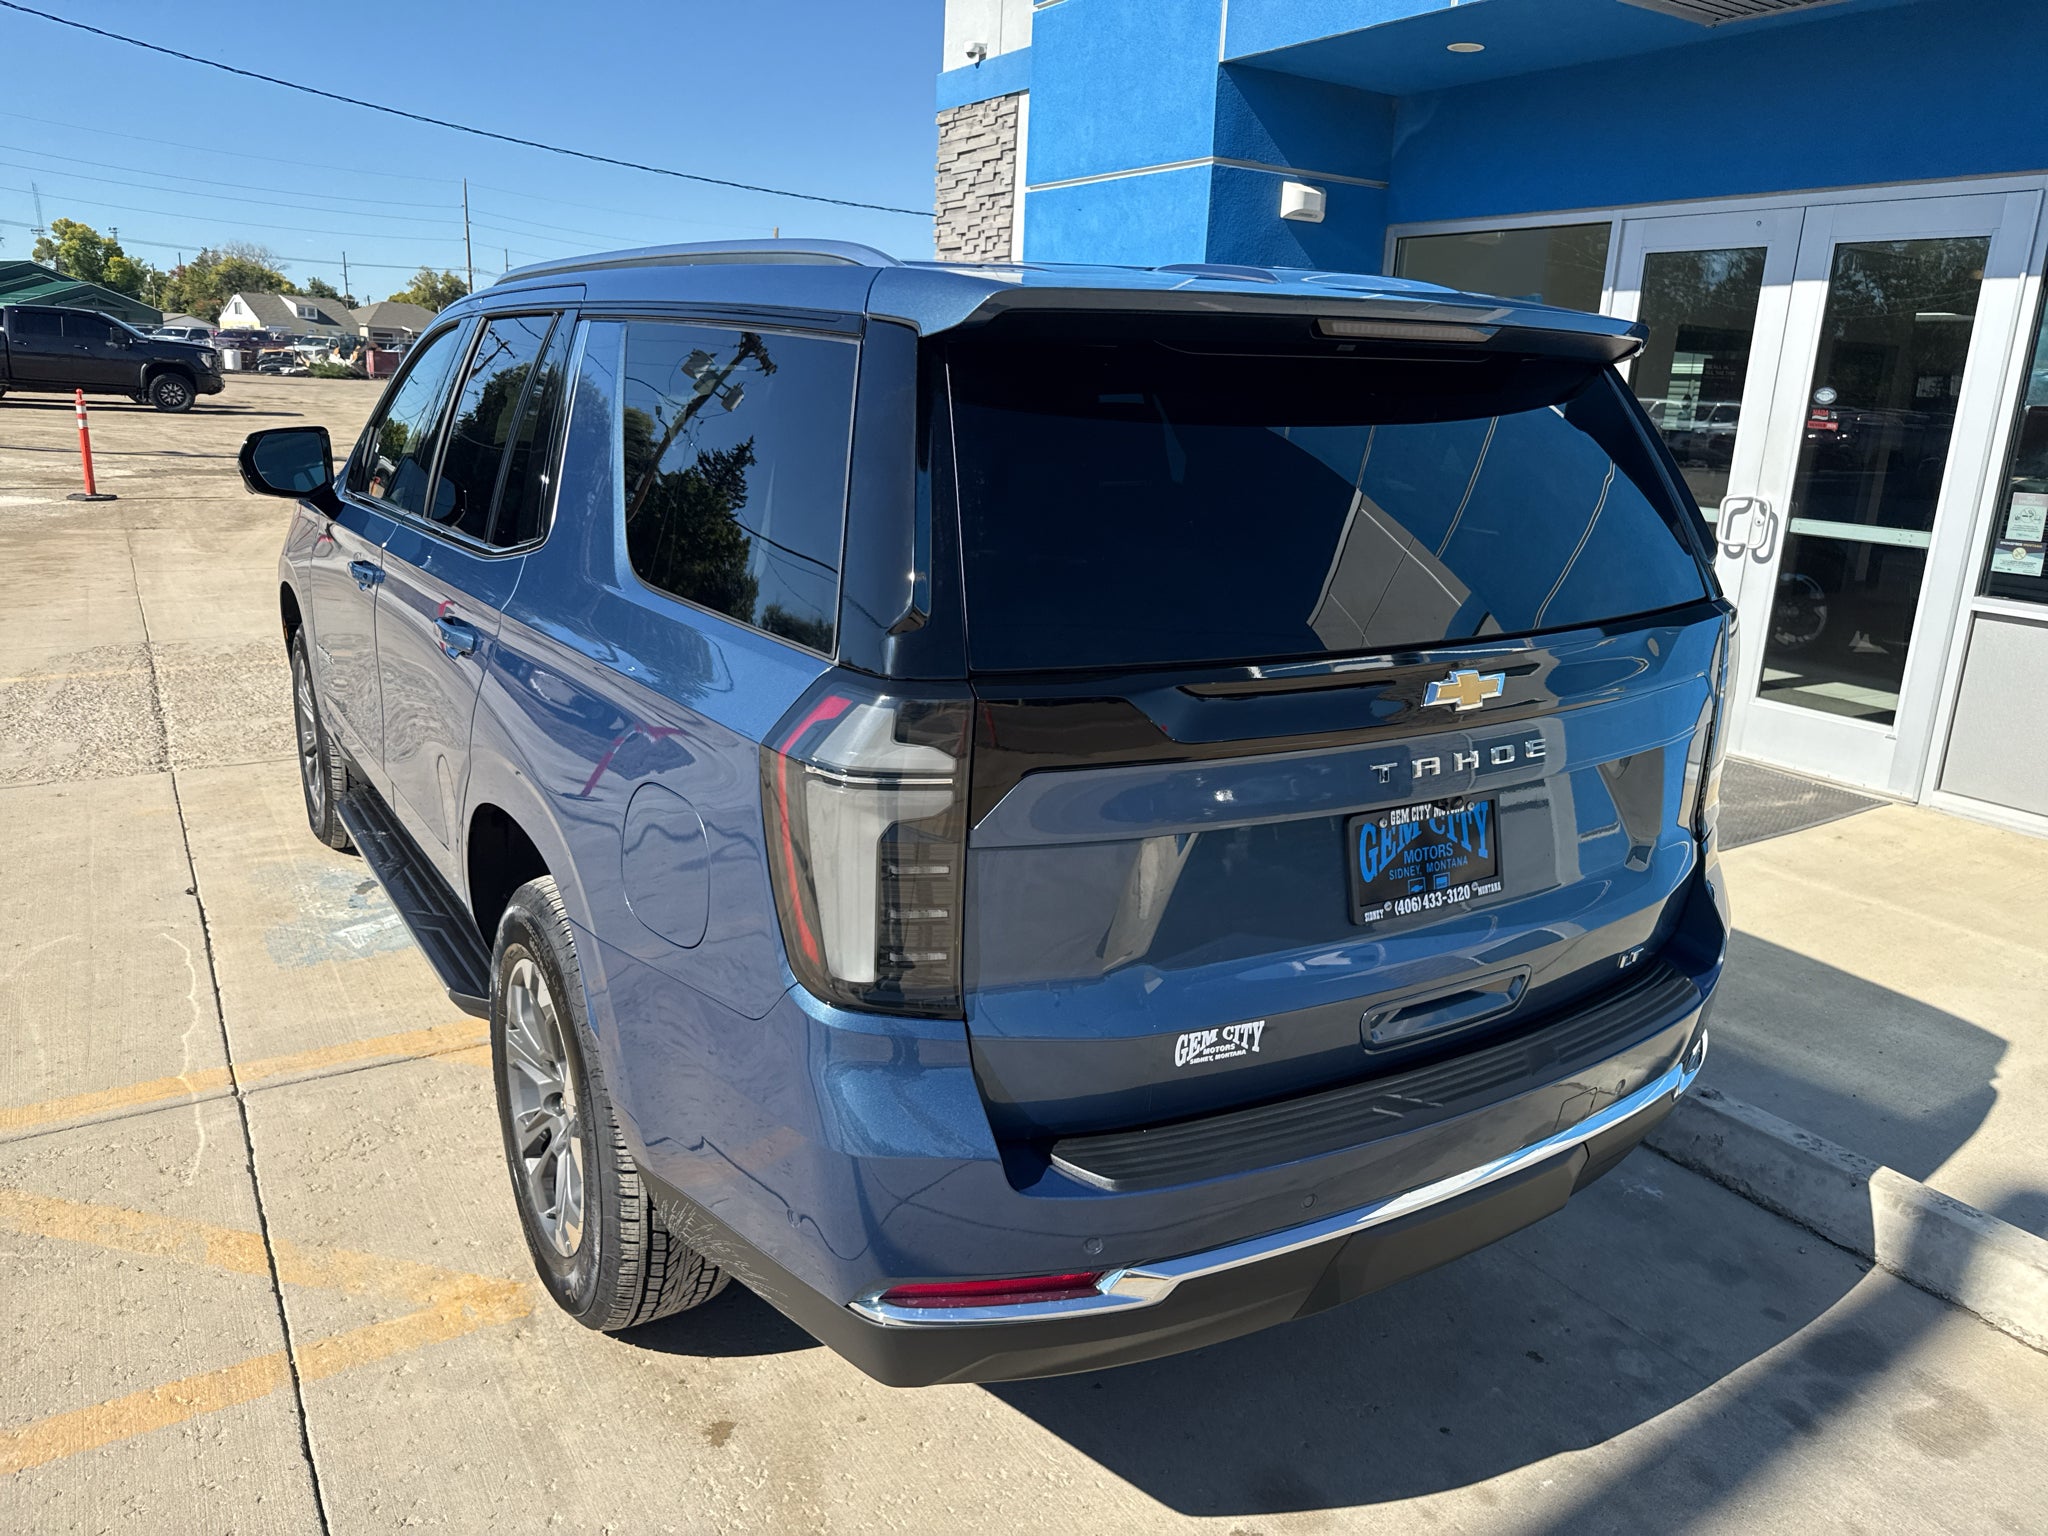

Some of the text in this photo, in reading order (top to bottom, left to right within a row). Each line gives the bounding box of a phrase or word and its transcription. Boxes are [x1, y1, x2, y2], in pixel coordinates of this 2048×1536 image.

[1369, 738, 1546, 784] TAHOE
[1390, 808, 1410, 825] GEM
[1411, 803, 1432, 822] CITY
[1359, 800, 1489, 883] GEM CITY
[1403, 842, 1454, 864] MOTORS
[1426, 855, 1468, 873] MONTANA
[1364, 908, 1385, 922] SIDNEY
[1477, 881, 1502, 896] MONTANA
[1617, 947, 1645, 969] LT
[1174, 1020, 1265, 1067] GEM CITY
[1202, 1043, 1236, 1055] MOTORS
[1214, 1049, 1247, 1061] MONTANA
